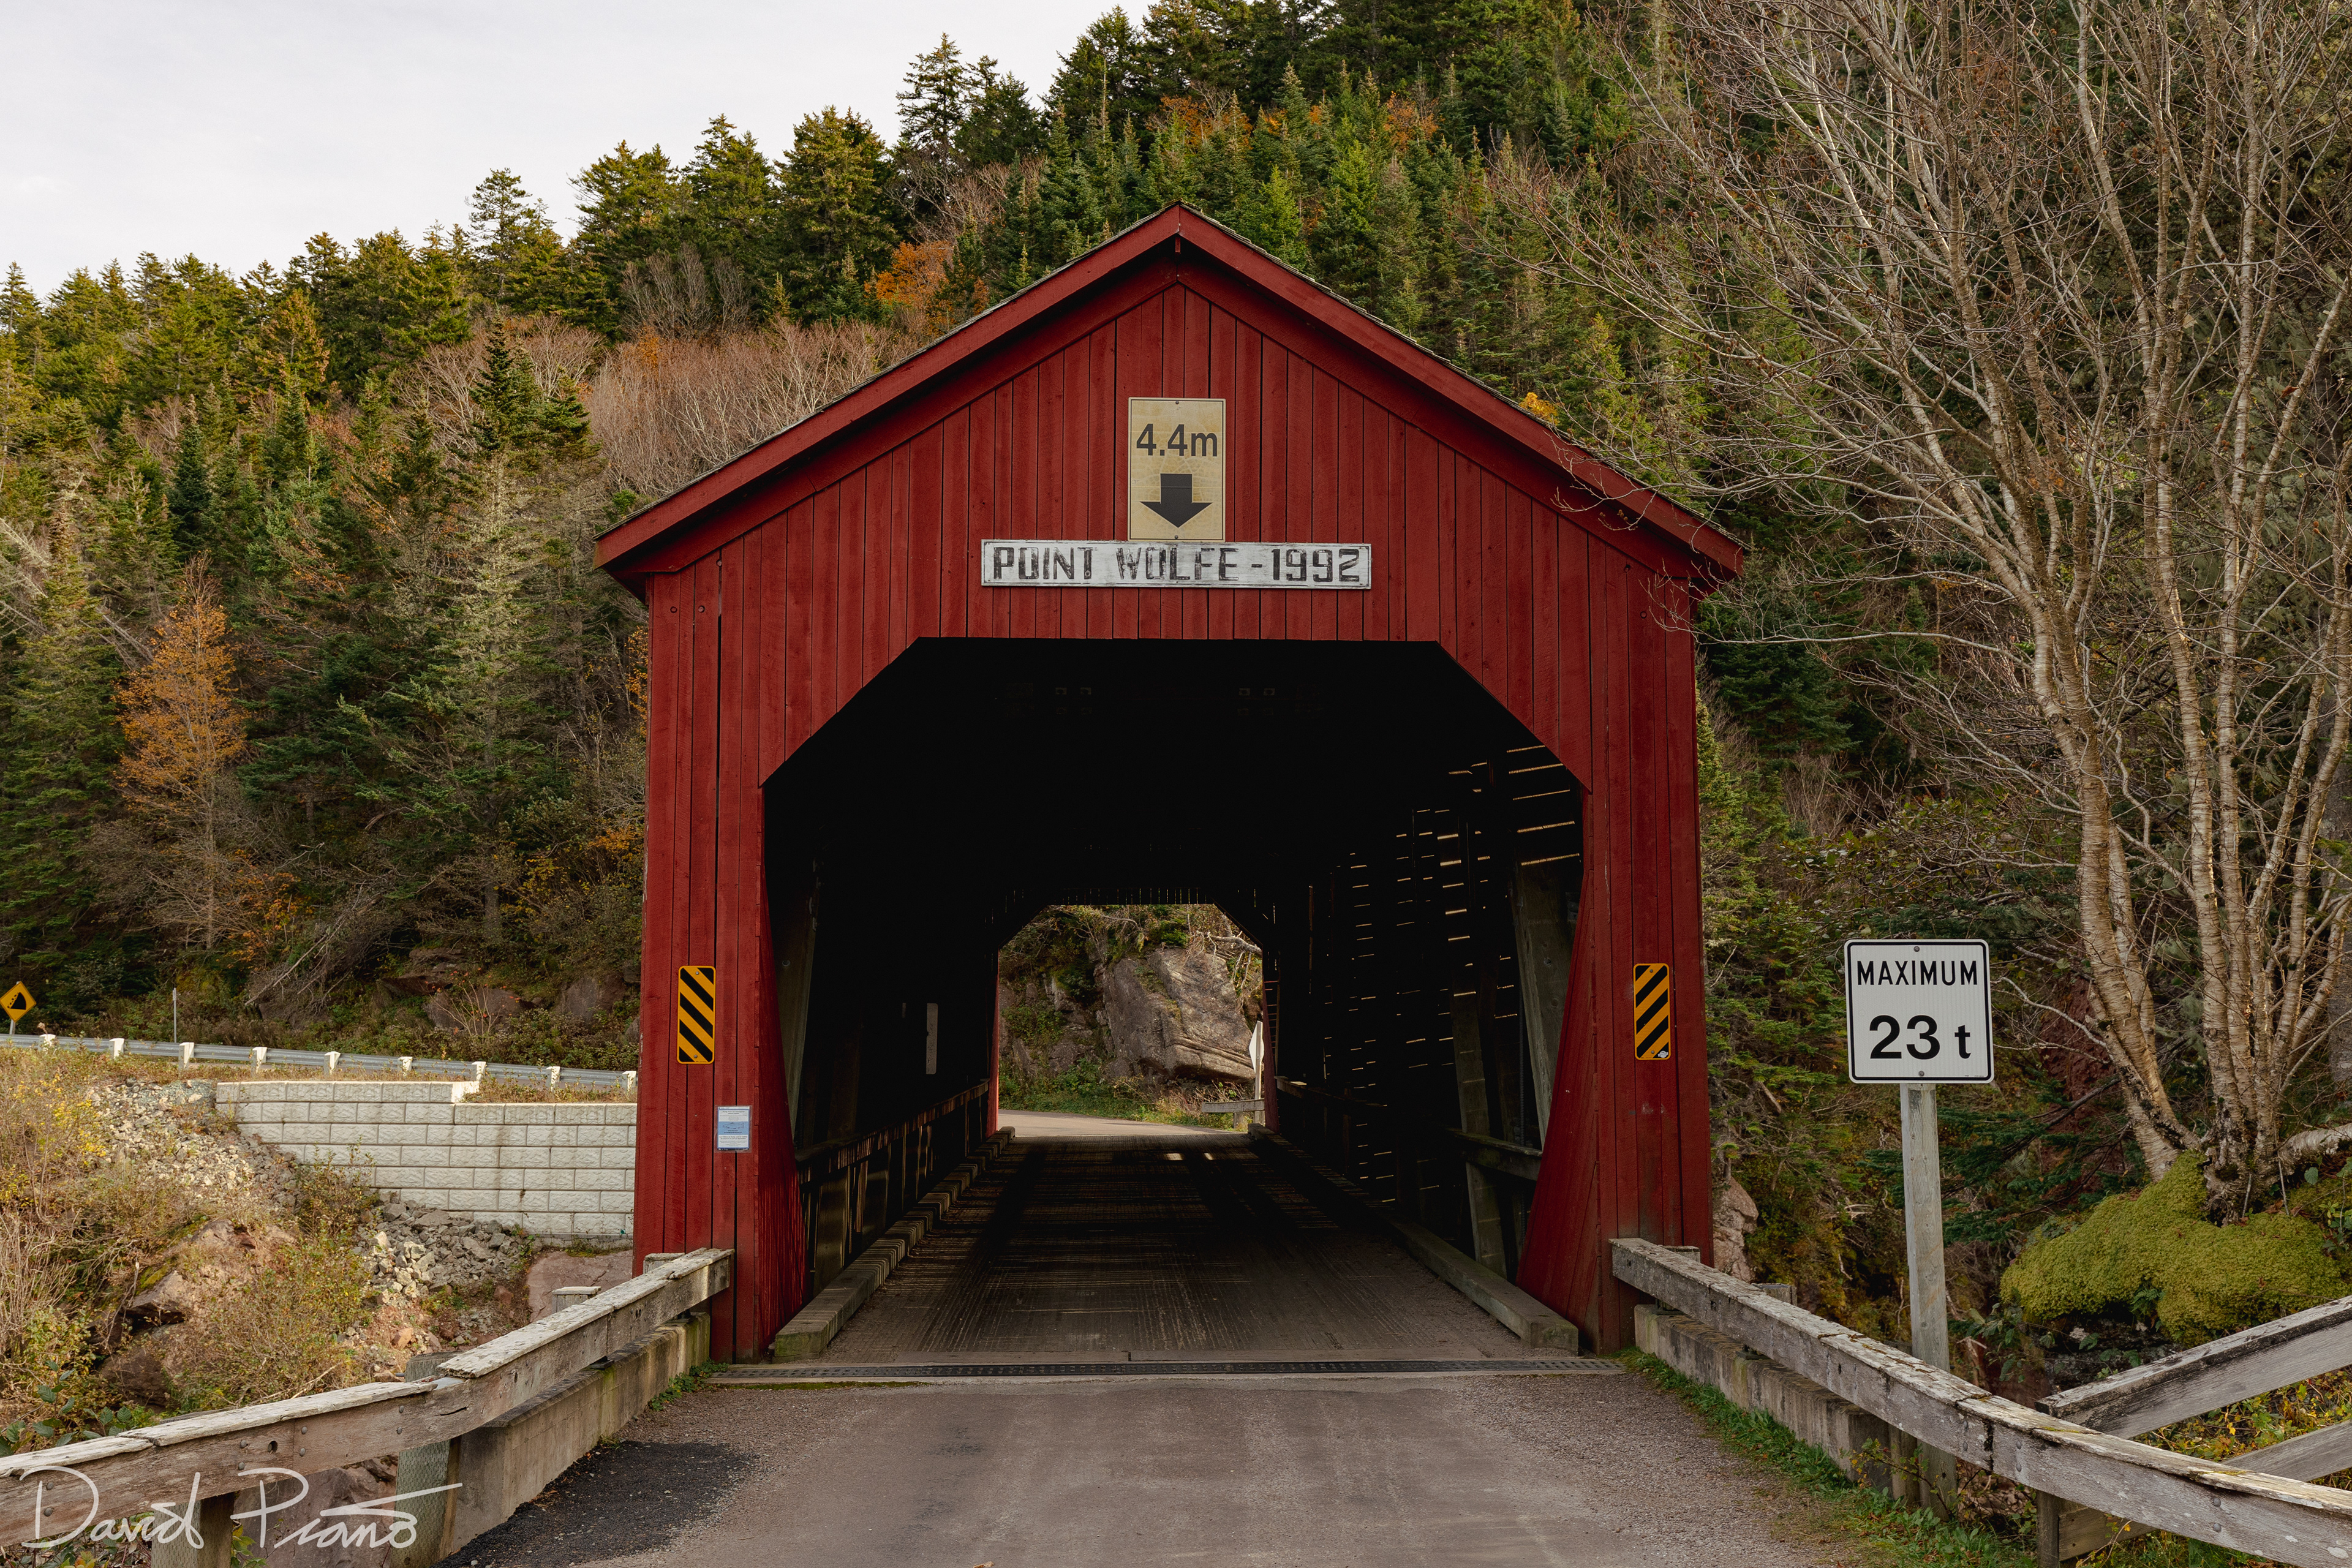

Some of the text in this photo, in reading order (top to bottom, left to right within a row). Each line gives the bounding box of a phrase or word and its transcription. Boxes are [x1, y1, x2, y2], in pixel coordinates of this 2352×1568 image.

[1136, 423, 1218, 457] 4.4m
[993, 546, 1098, 579] POINT
[1115, 546, 1239, 581] WOLFE
[1271, 548, 1360, 582] 1992
[1857, 960, 1978, 986] MAXIMUM
[1869, 1014, 1972, 1060] 23 t
